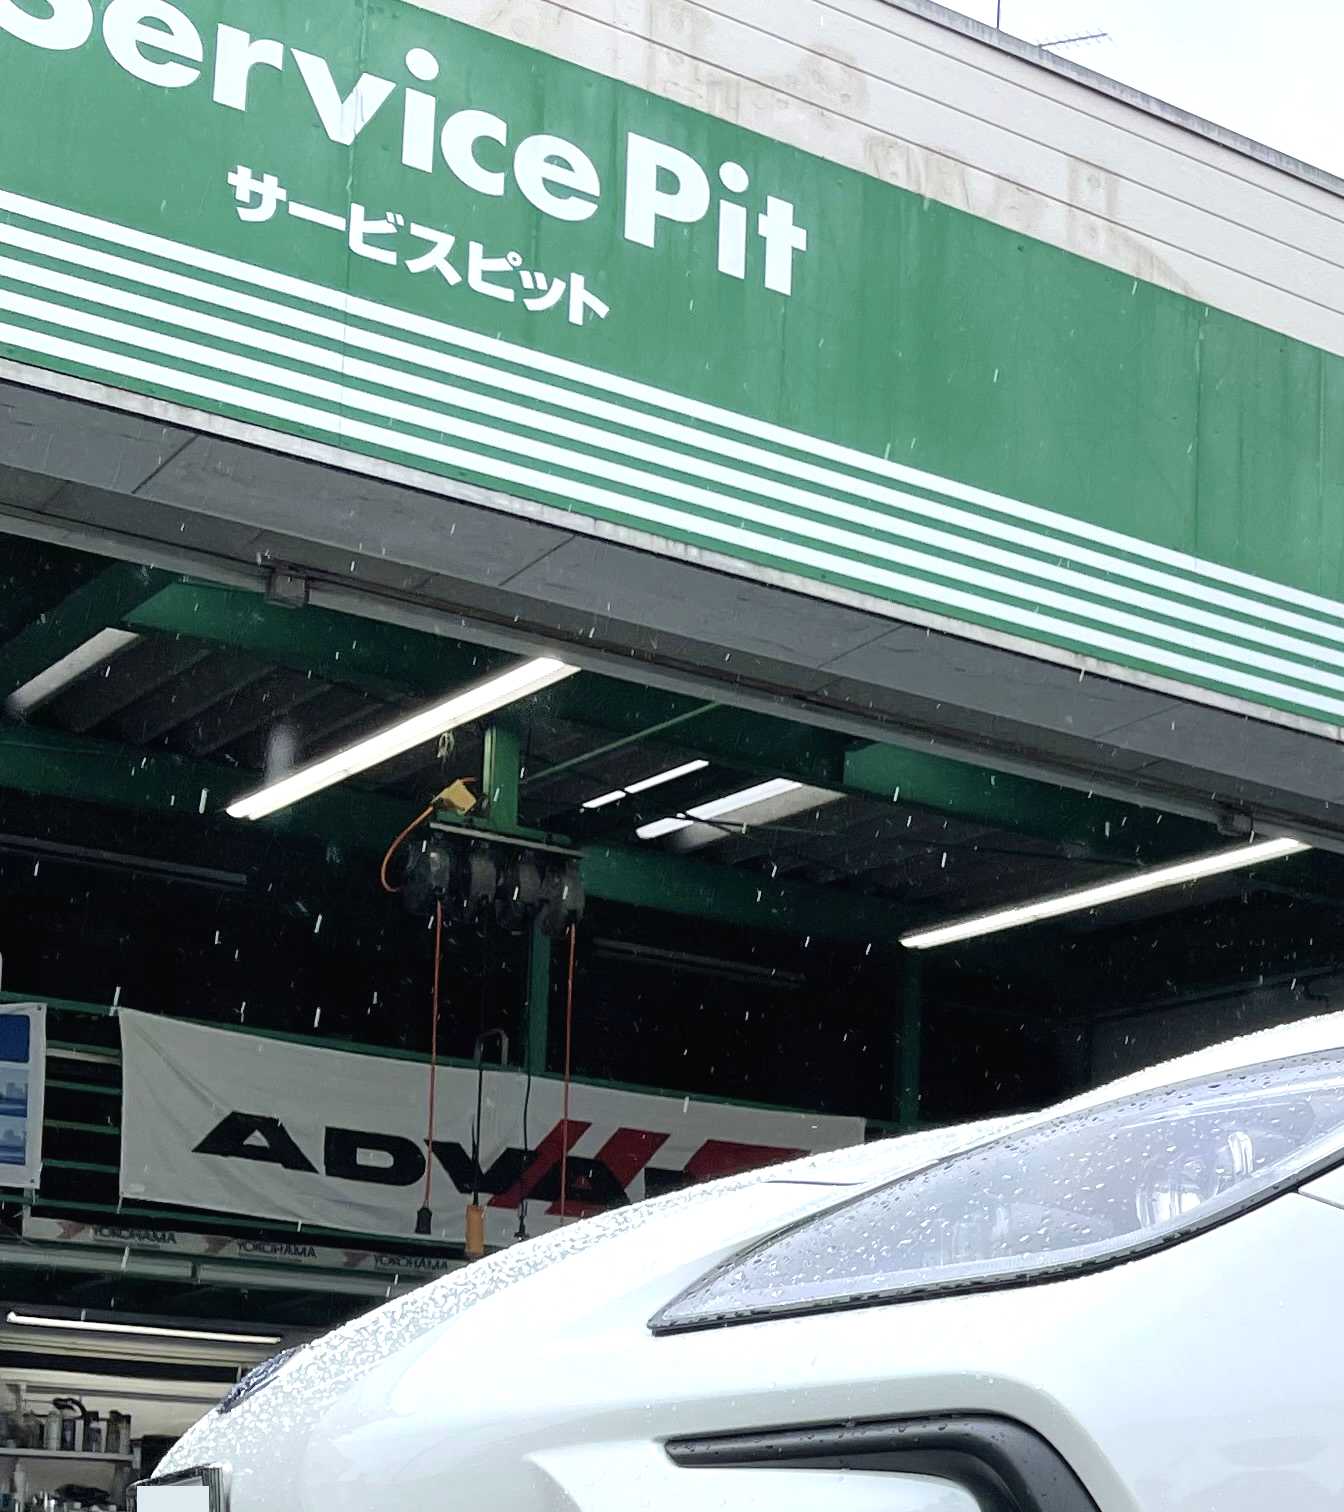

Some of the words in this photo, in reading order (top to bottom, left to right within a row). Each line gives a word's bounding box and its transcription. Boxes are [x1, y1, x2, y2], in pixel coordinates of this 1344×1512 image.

[227, 164, 610, 327] サービスピット
[624, 131, 808, 297] Pit
[237, 1238, 318, 1258] YOKOHAMA
